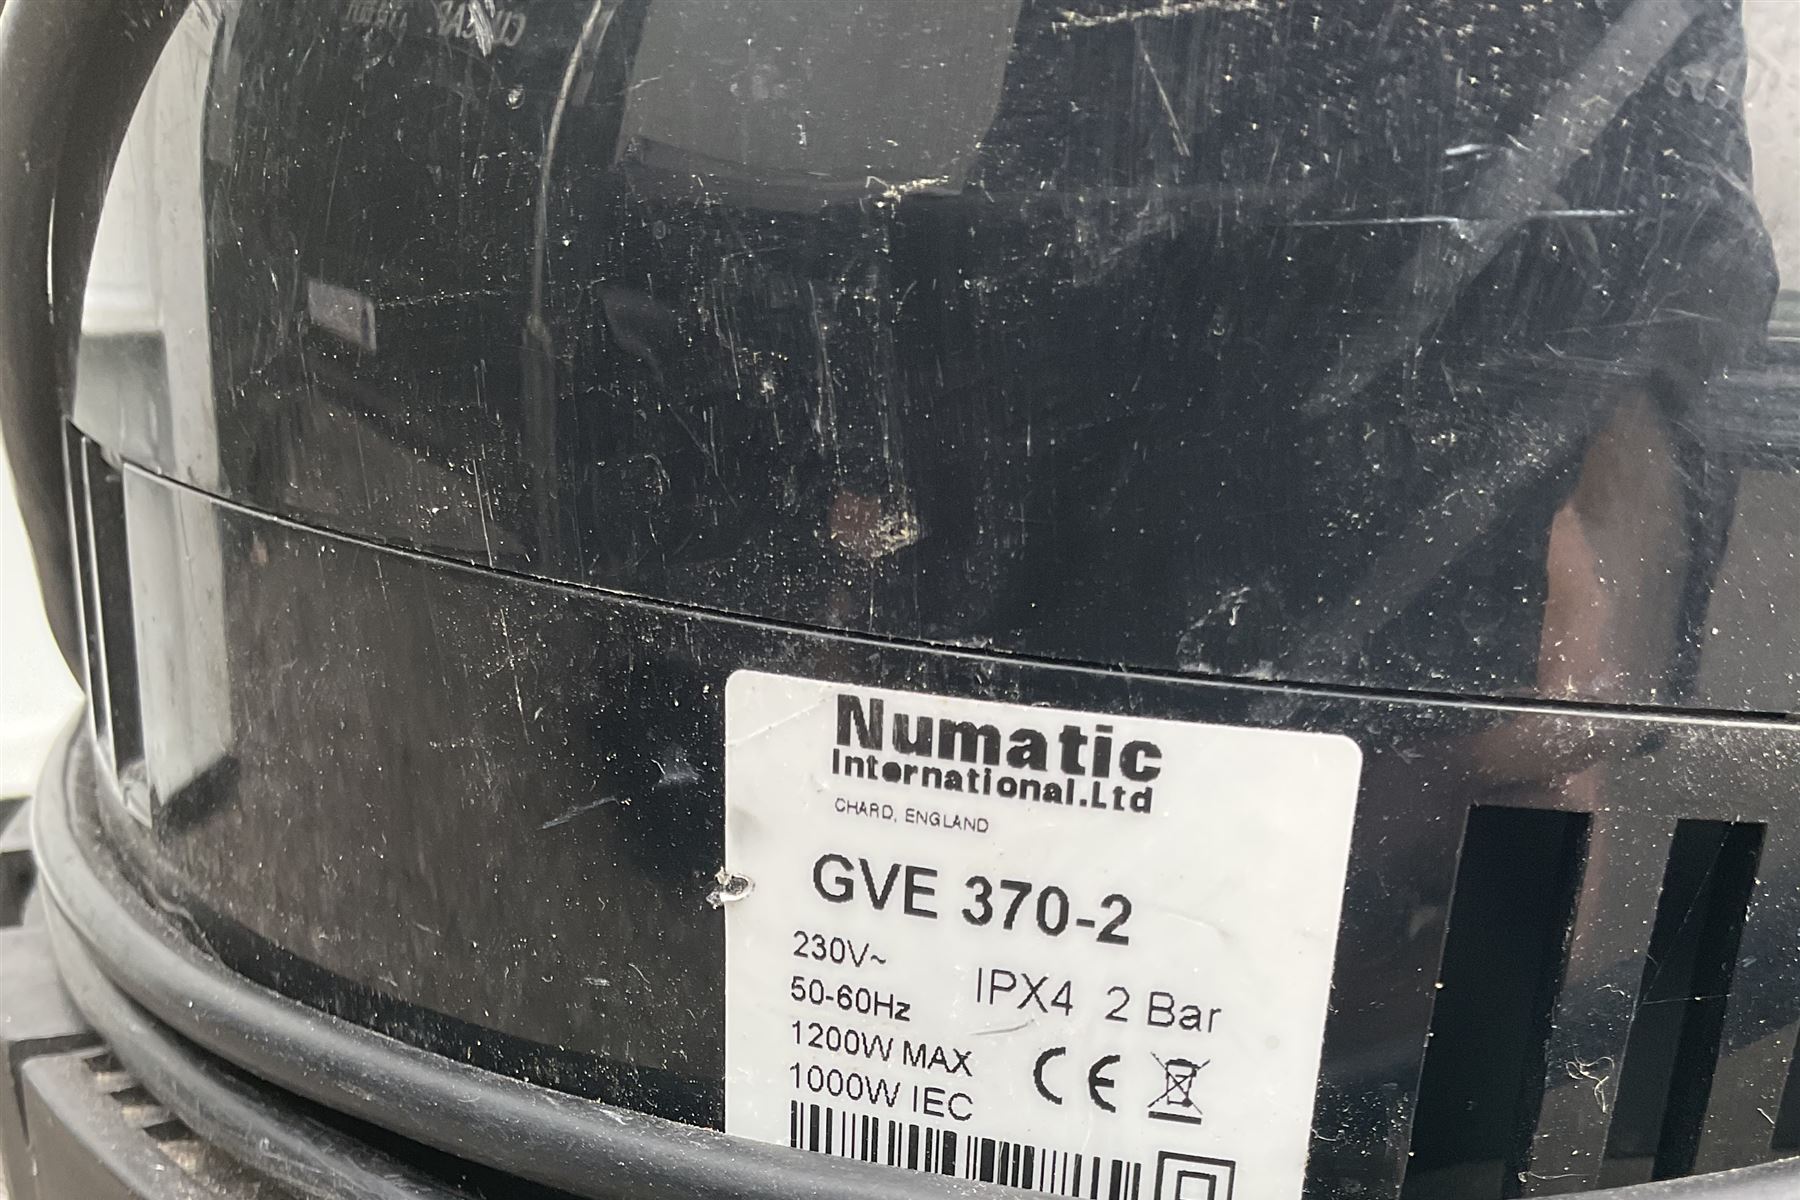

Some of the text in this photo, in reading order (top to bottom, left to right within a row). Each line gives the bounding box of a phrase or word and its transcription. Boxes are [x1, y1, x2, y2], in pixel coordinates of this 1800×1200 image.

[837, 694, 1162, 782] Numatic
[905, 808, 990, 833] ENGLAND
[813, 854, 1132, 945] GVE 370-2
[791, 976, 910, 1021] 50-60Hz
[977, 968, 1222, 1033] IPX4 2 Bar
[792, 1020, 972, 1077] 1200W MAX
[790, 1062, 974, 1121] 1000W IEC
